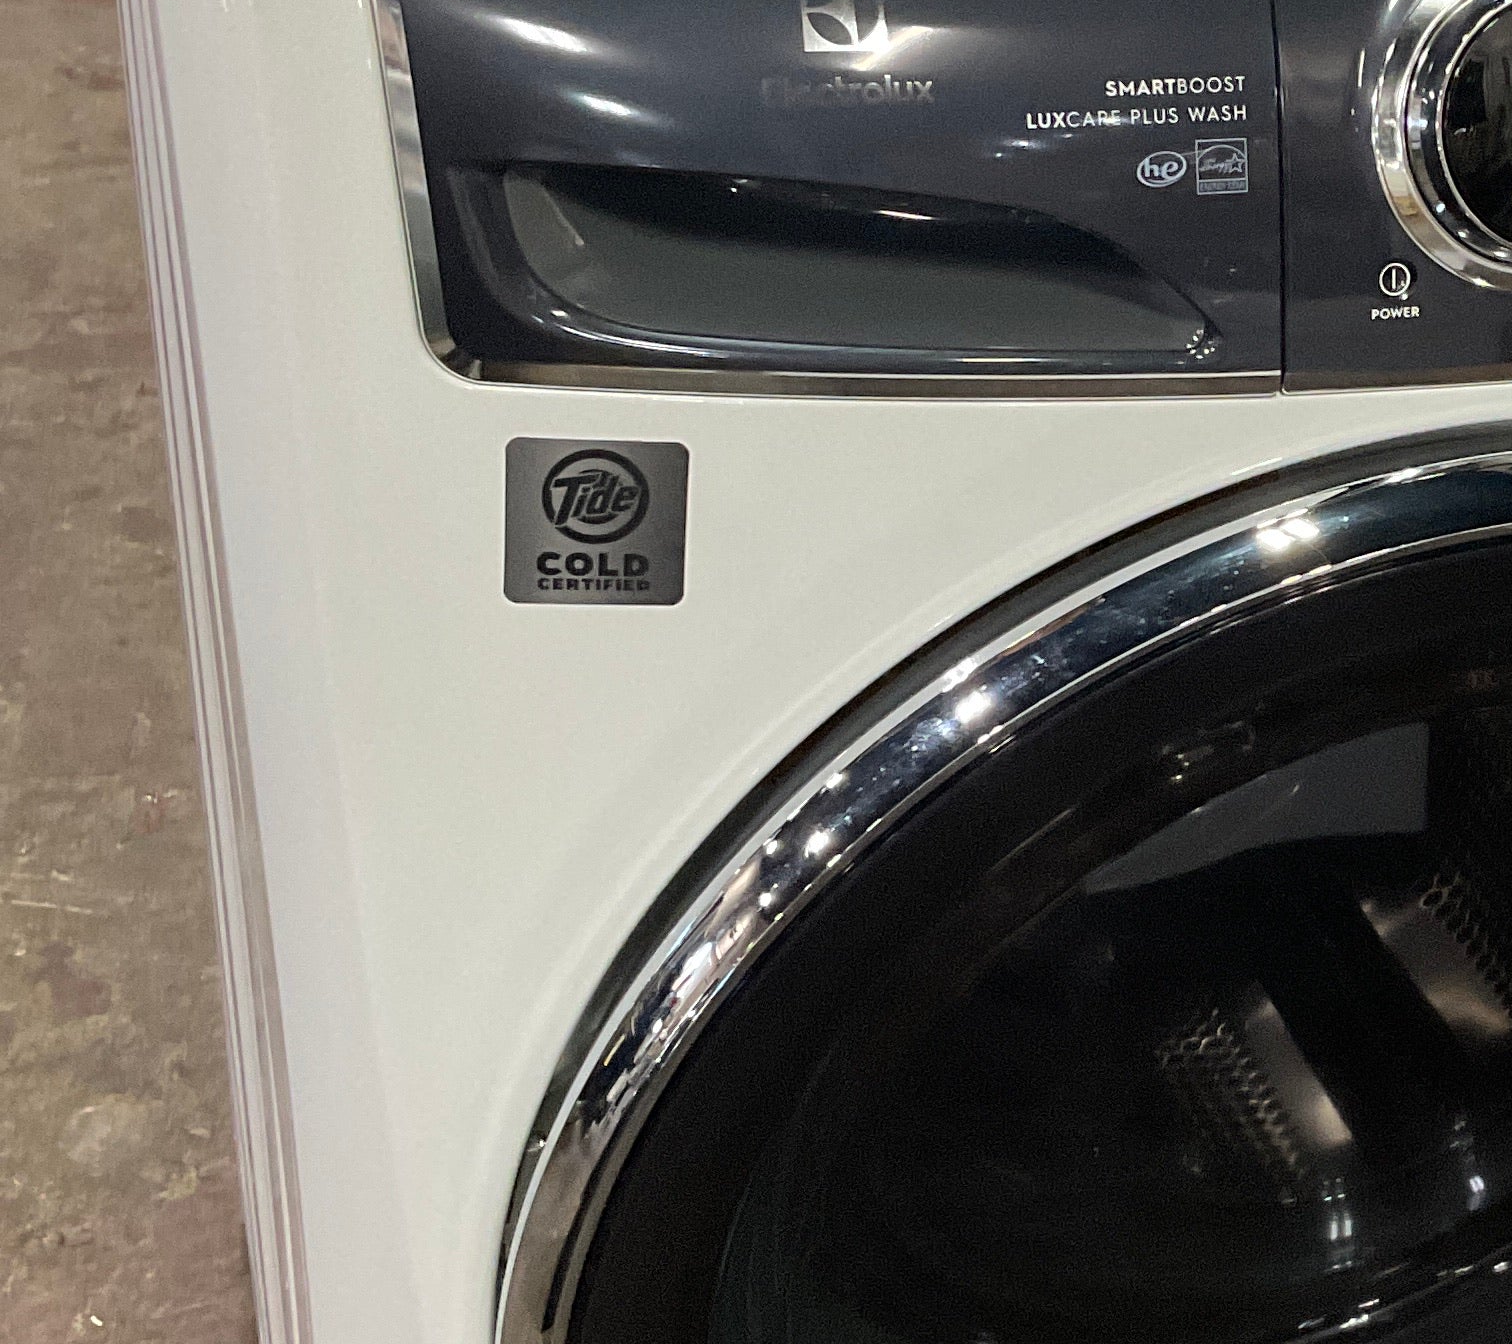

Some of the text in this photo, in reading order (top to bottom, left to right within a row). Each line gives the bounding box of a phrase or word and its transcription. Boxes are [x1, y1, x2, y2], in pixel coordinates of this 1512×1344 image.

[1105, 75, 1246, 97] SMARTBOOST
[1026, 104, 1247, 130] LUXCARE PLUS WASH
[1371, 306, 1420, 320] POWER
[553, 471, 641, 526] Tide
[536, 551, 650, 577] COLD
[537, 577, 650, 591] CERTIFIED
